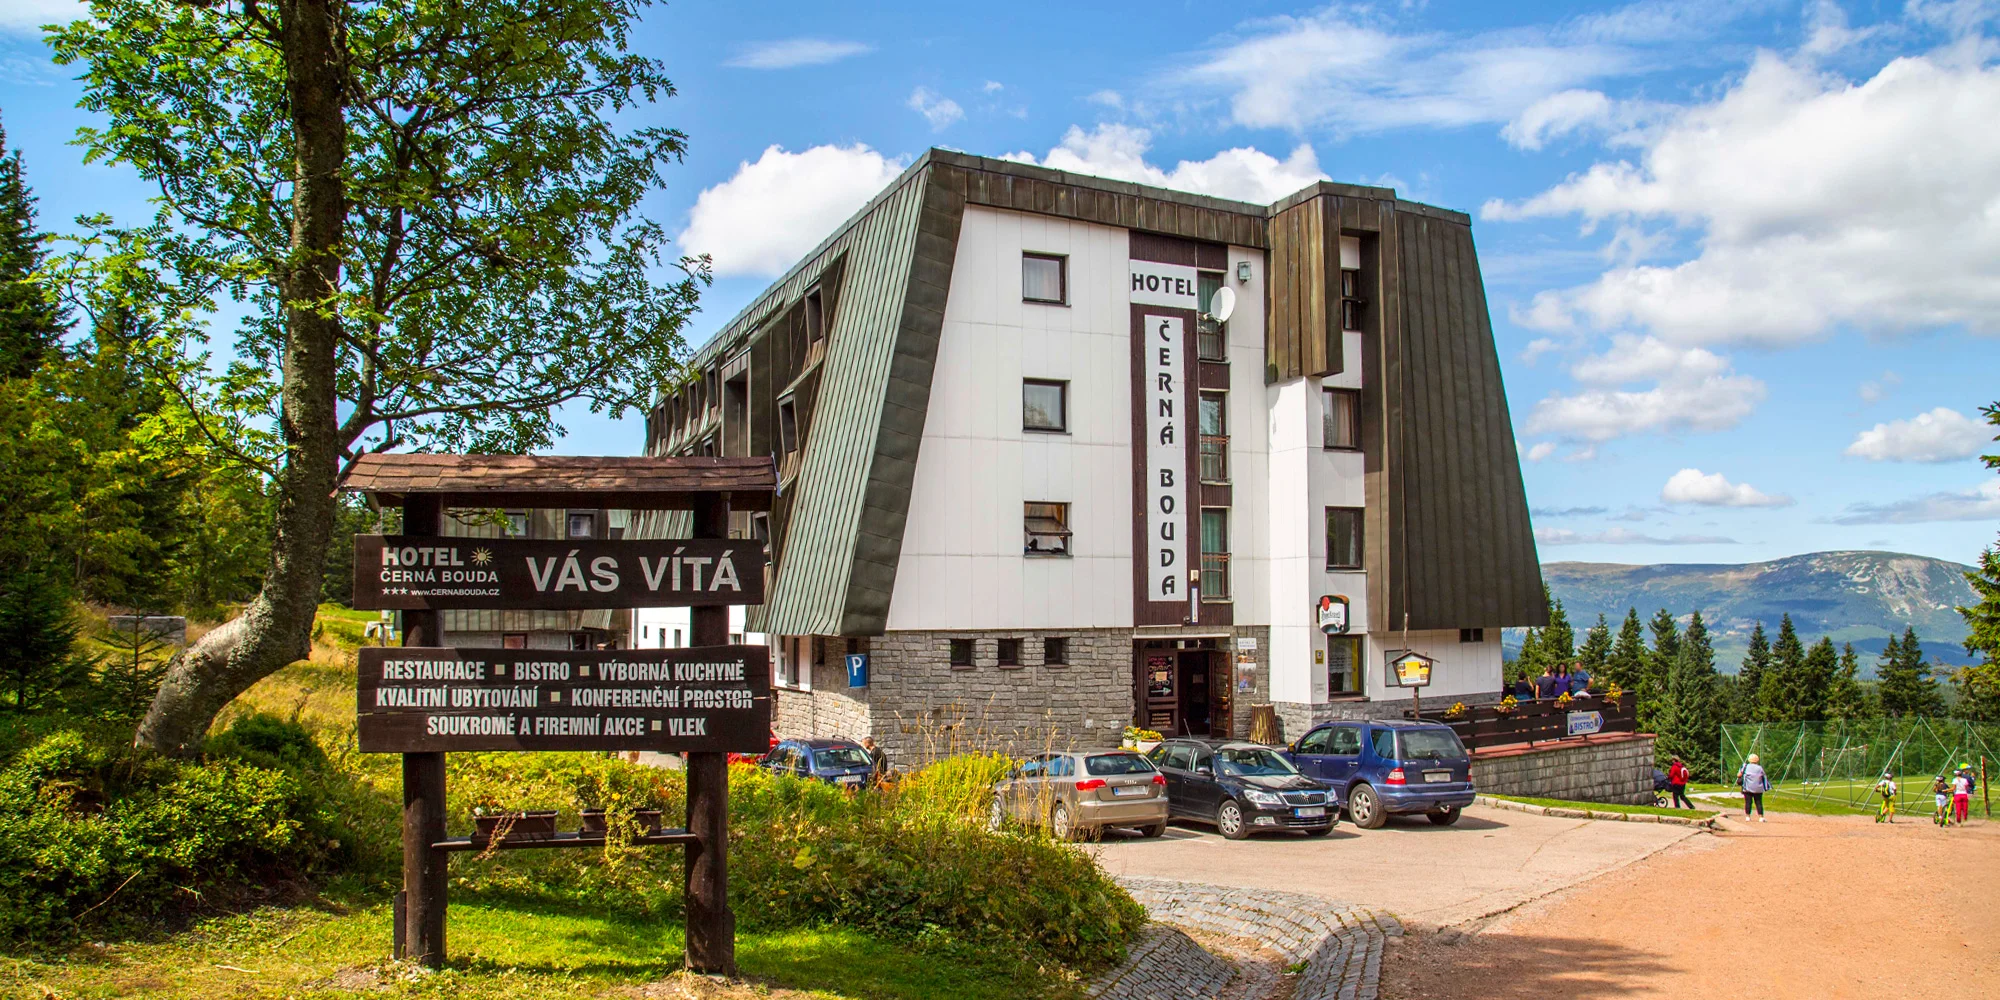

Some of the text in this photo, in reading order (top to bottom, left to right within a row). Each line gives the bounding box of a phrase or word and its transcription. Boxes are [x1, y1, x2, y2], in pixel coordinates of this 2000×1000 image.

[1132, 273, 1196, 296] HOTEL
[1158, 319, 1175, 596] ČERNÁ BOUDA
[382, 547, 464, 567] HOTEL
[380, 567, 499, 583] ČERNÁ BOUDA
[525, 546, 742, 593] VÁS VÍTÁ
[411, 588, 500, 597] www.CERNABOUDA.CZ
[383, 659, 745, 681] RESTAURACE BISTRO VÝBORNÁ KUCHYNĚ
[851, 656, 863, 676] P
[376, 684, 752, 709] KVALITNÍ UBYTOVÁNÍ KONFERENČNÍ PROSTOR
[427, 713, 706, 737] SOUKROMÉ A FIREMNÍ AKCE VLEK
[1573, 721, 1594, 731] BISTRO
